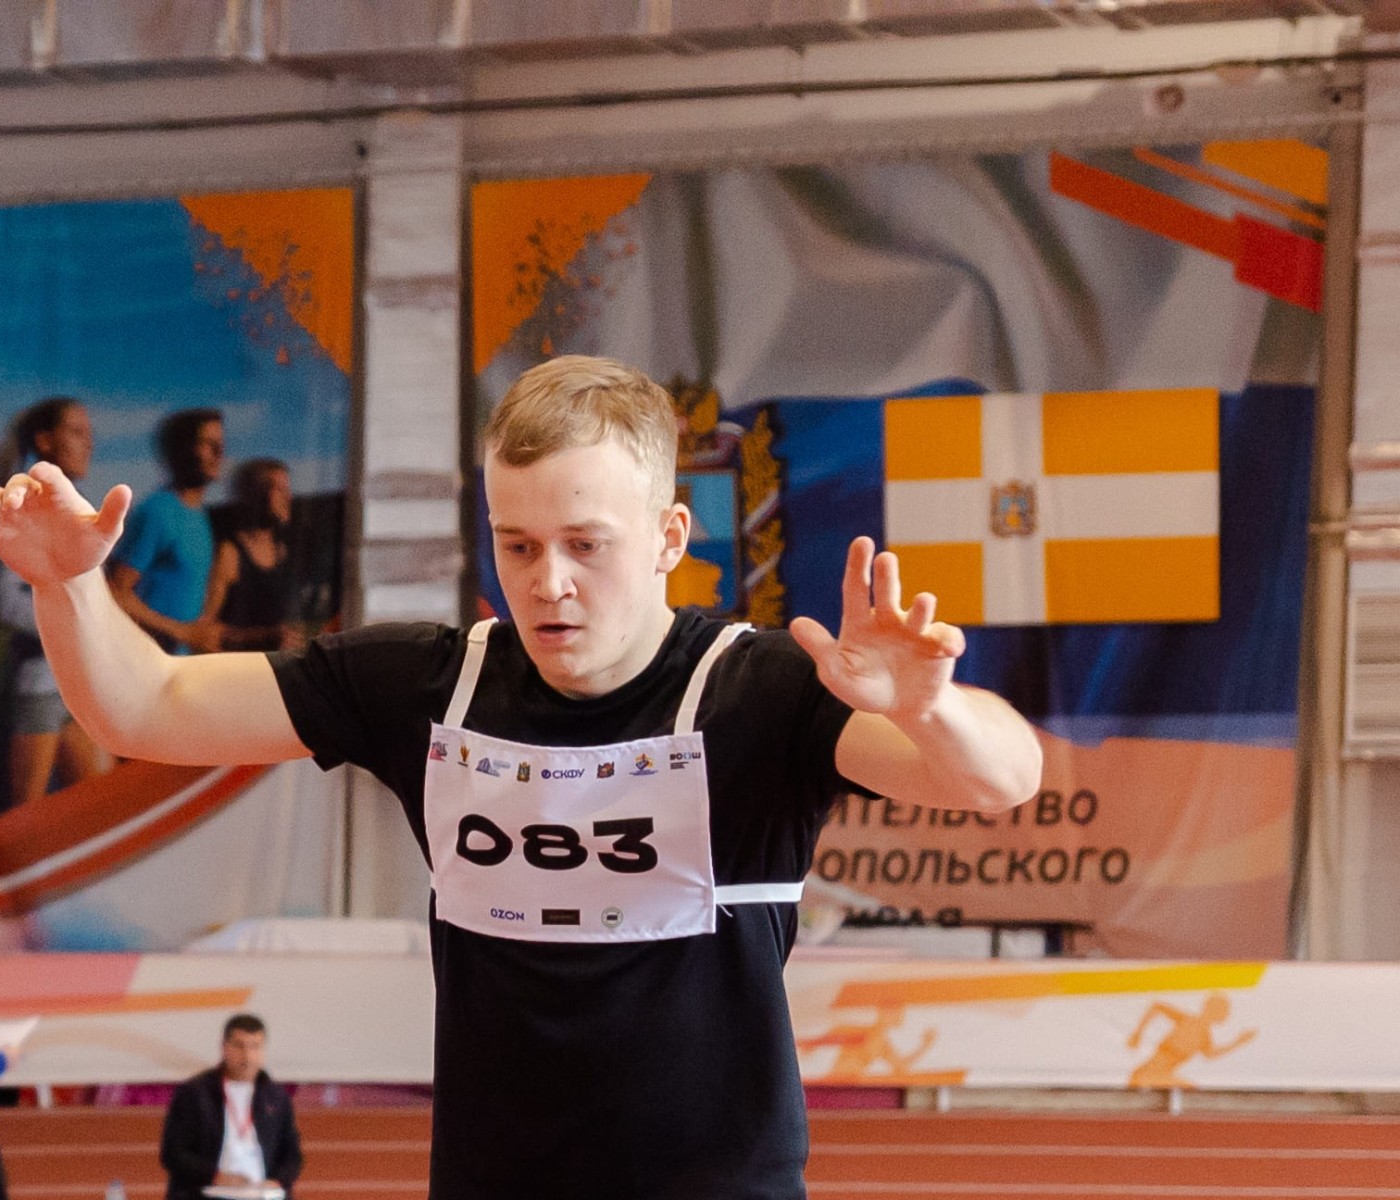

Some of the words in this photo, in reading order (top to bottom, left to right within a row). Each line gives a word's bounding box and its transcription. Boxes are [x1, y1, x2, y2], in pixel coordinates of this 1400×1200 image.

[552, 768, 585, 779] СКФУ
[456, 813, 658, 873] 083
[490, 907, 525, 921] OZON
